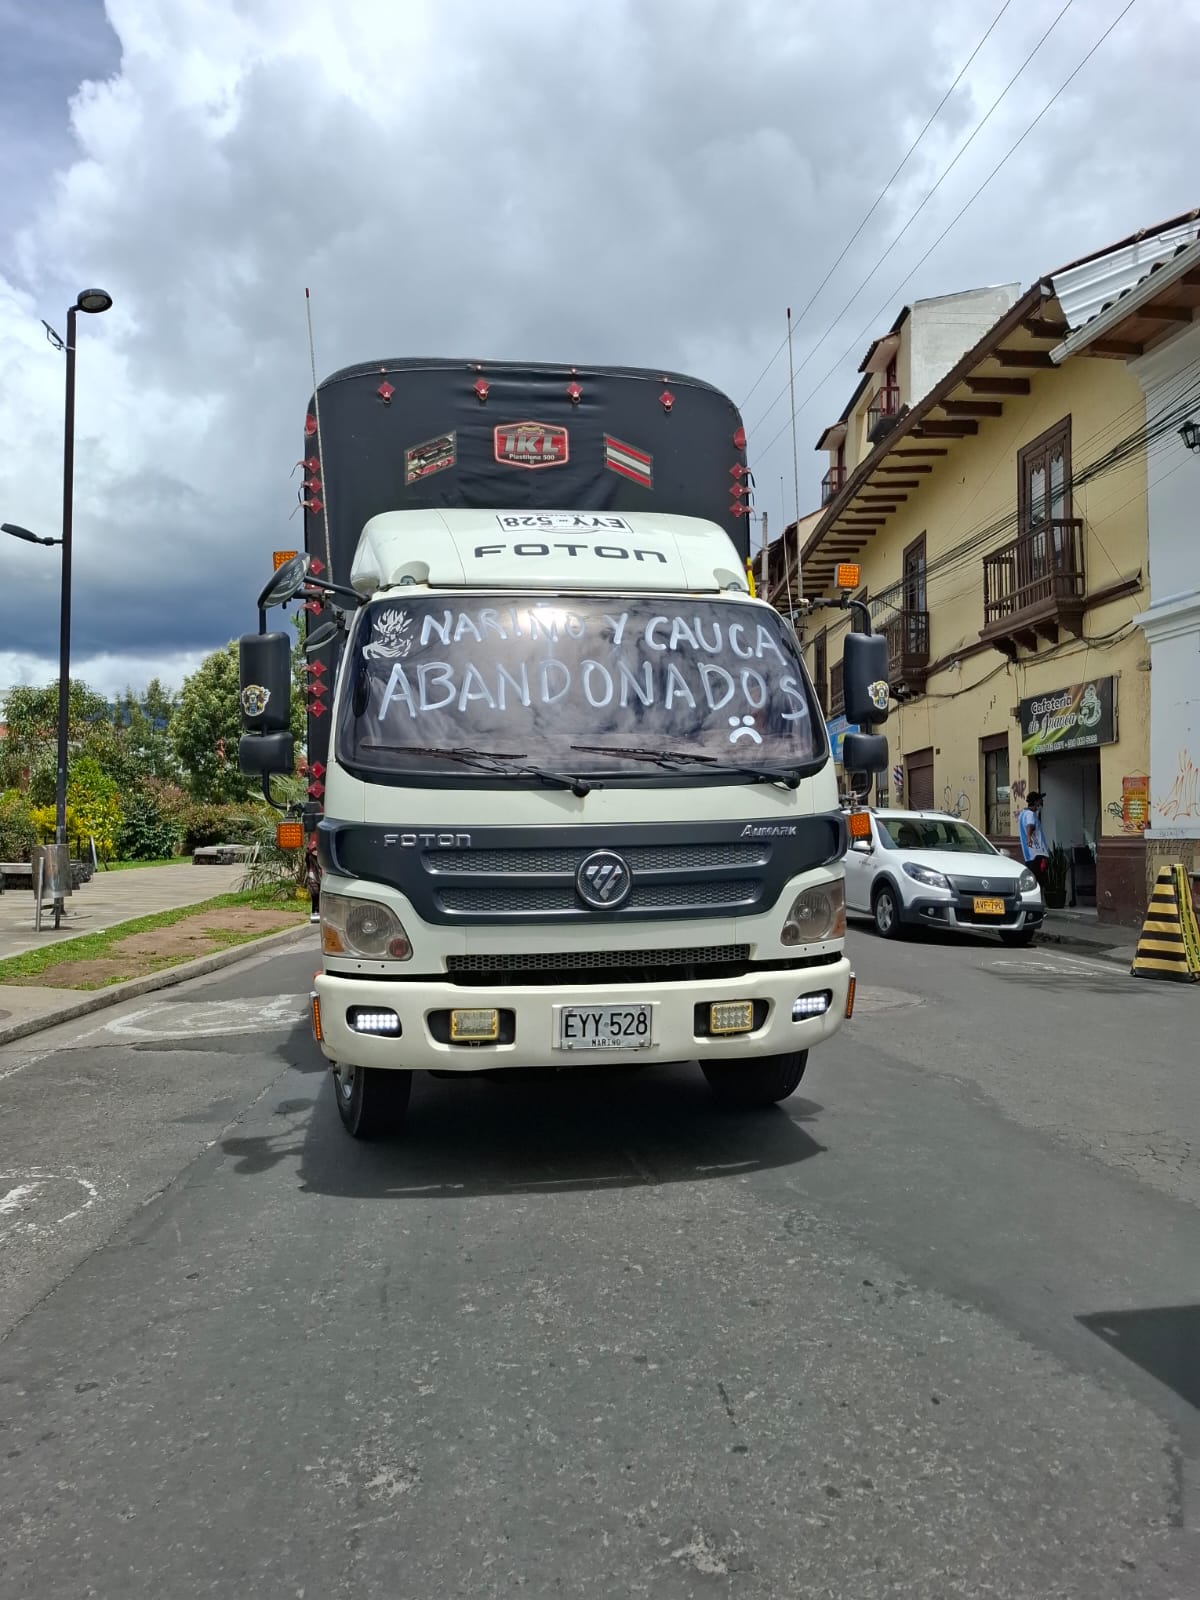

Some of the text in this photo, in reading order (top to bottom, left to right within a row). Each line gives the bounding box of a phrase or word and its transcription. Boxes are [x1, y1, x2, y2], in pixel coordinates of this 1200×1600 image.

[505, 435, 559, 454] IKL
[503, 516, 552, 527] 528
[604, 612, 628, 645] Y
[644, 615, 788, 666] CAUCA
[379, 660, 807, 721] ABANDONADOS
[383, 833, 472, 848] FOTON
[565, 1012, 648, 1037] EYY 528
